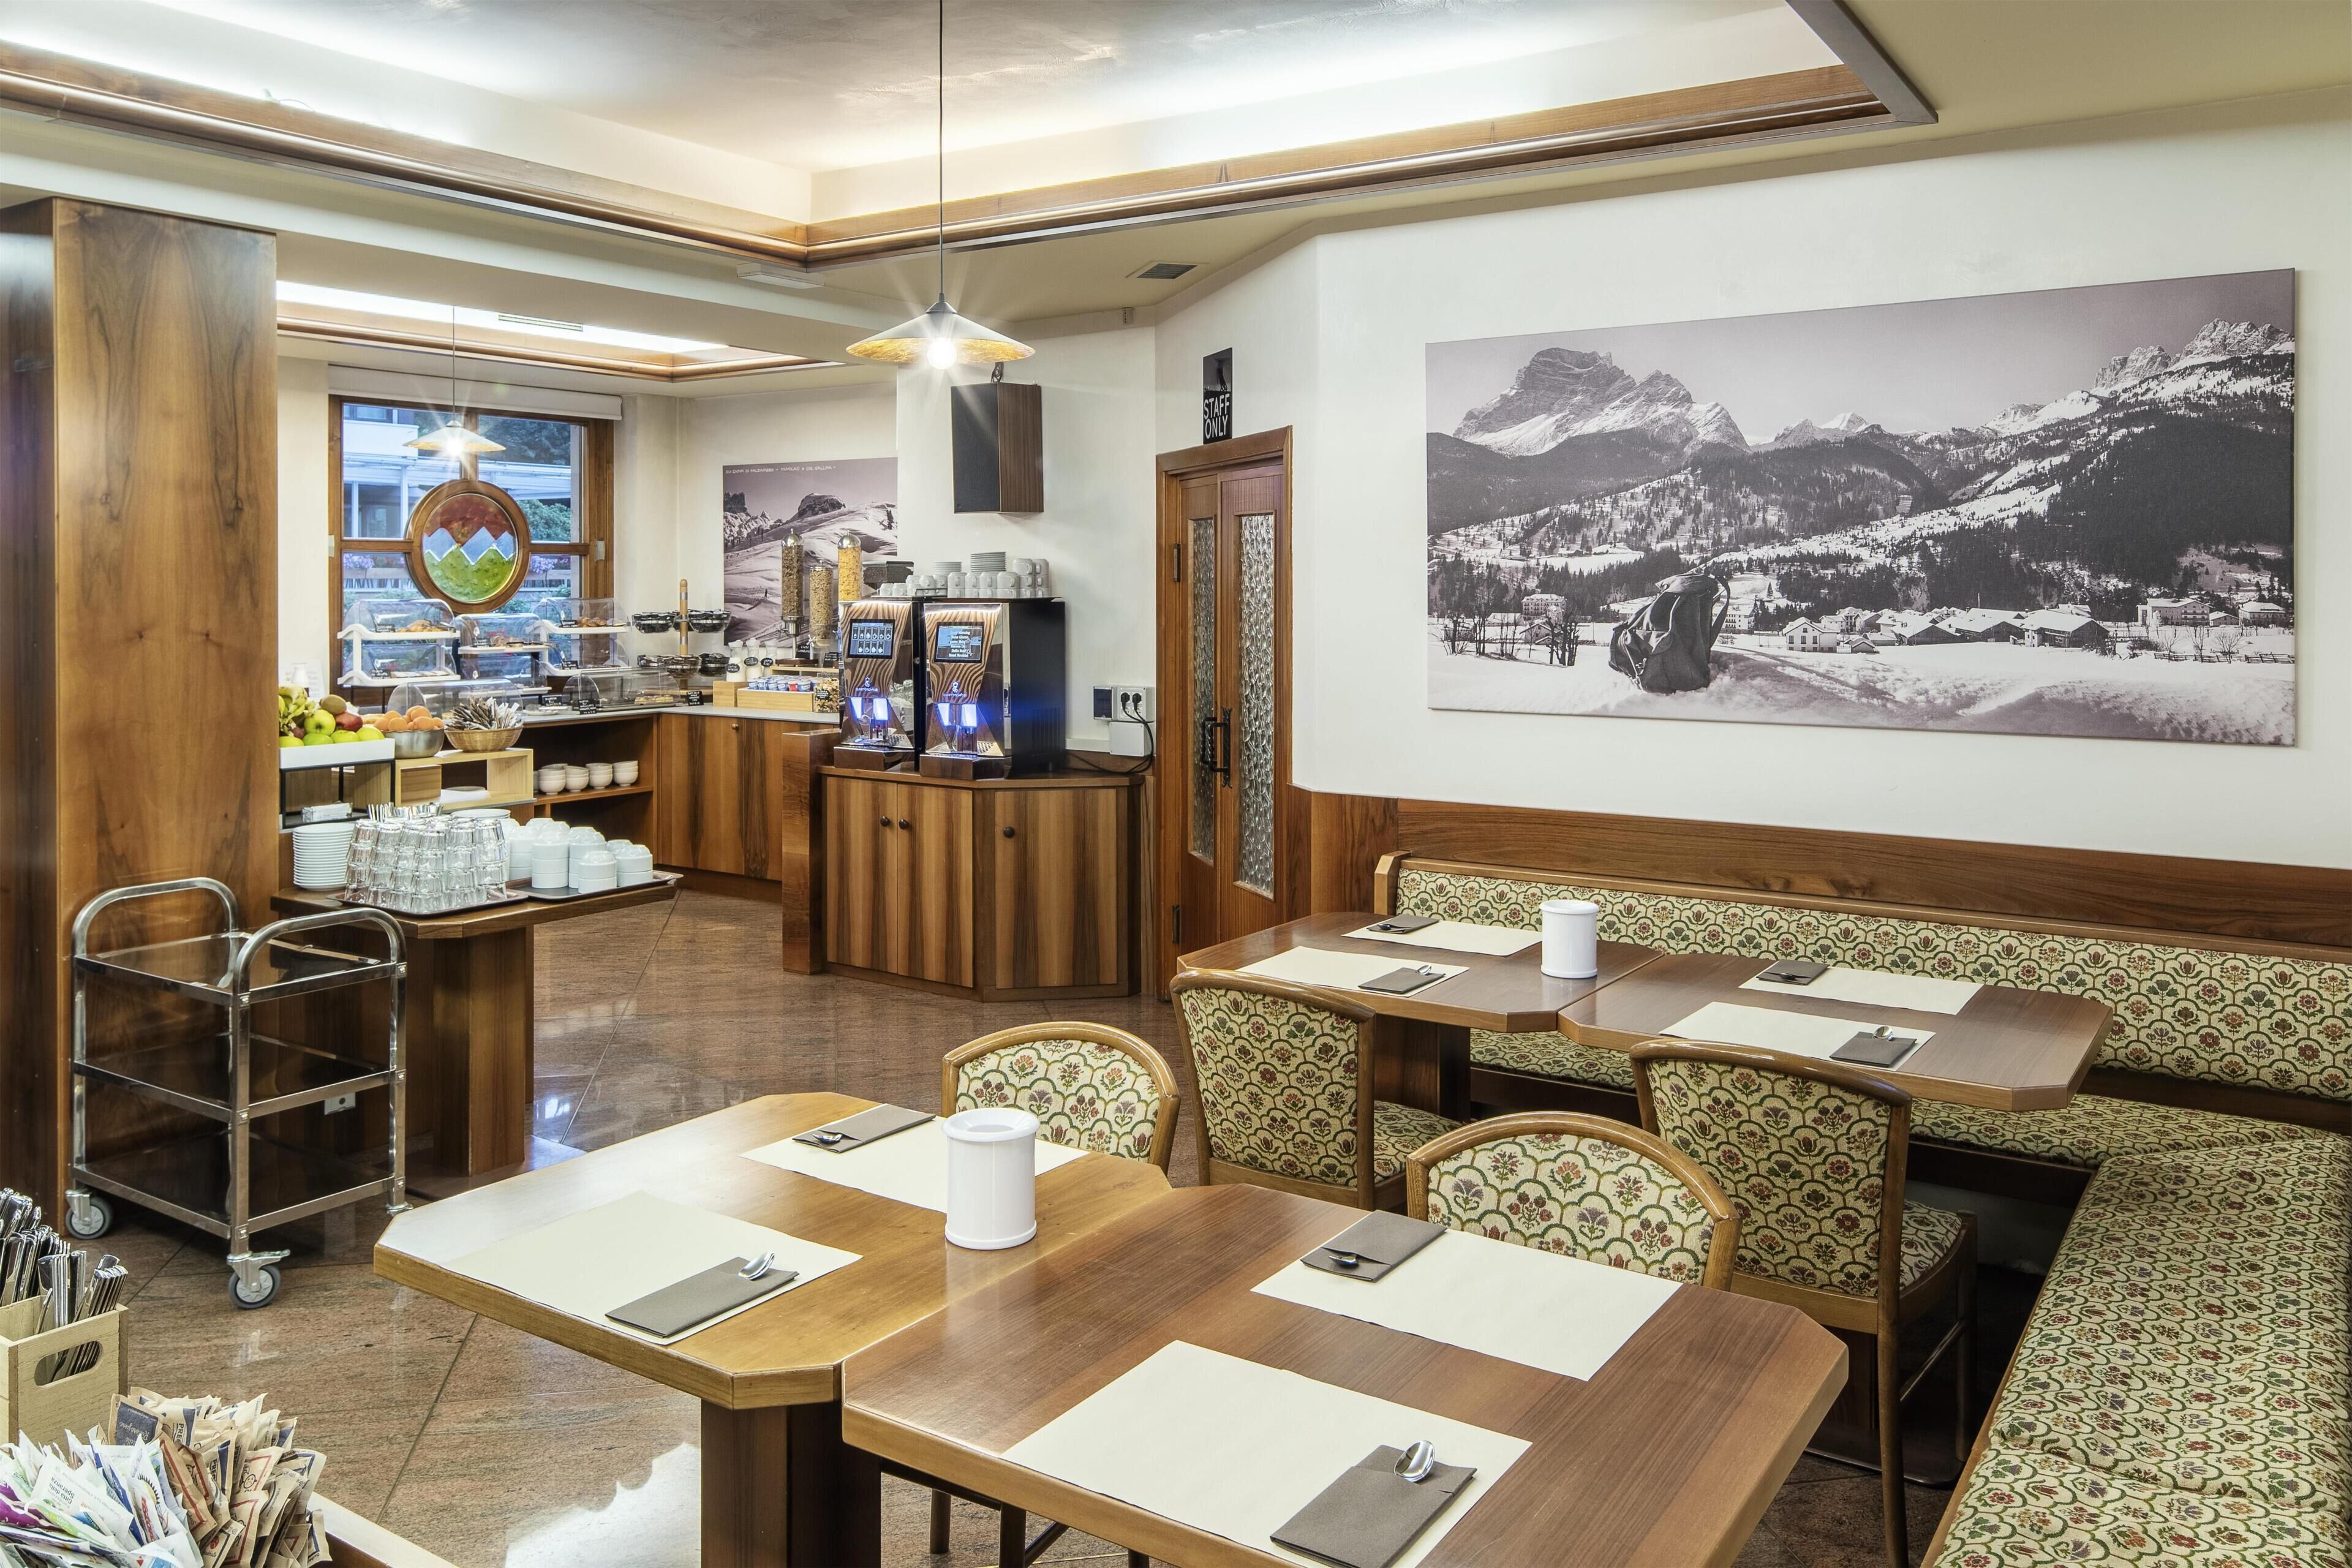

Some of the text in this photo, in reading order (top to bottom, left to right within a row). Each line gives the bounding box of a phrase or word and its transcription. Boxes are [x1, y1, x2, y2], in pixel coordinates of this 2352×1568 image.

[1204, 393, 1230, 420] STAFF
[1205, 415, 1228, 439] ONLY
[50, 1476, 76, 1499] Speranza
